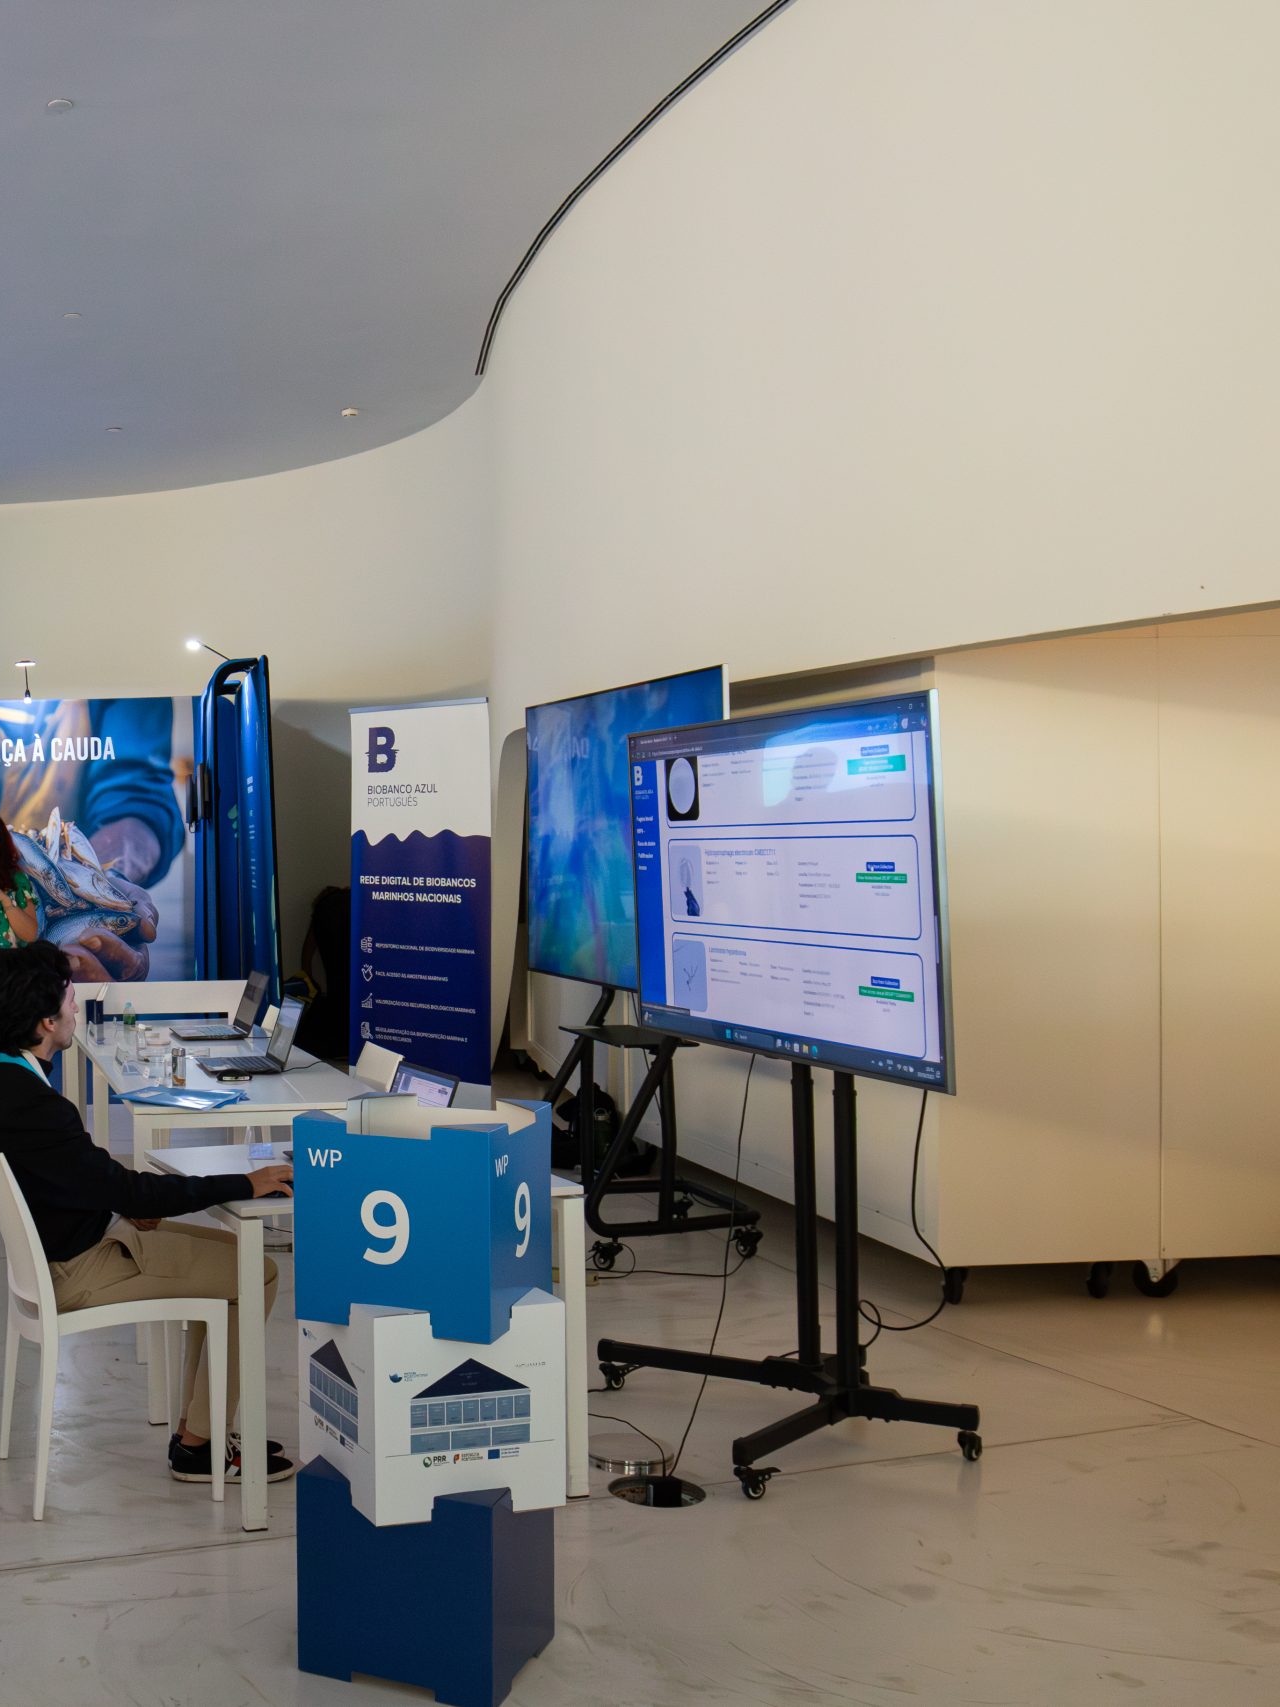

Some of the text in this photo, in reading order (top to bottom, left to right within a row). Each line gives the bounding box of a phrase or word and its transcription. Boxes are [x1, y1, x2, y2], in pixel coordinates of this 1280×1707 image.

[32, 733, 45, 762] À
[51, 736, 116, 762] CAUDA
[366, 726, 399, 774] B
[367, 783, 438, 795] BIOBANCO AZUL
[367, 796, 418, 808] PORTUGUÊS
[359, 875, 477, 888] REDE DIGITAL DE BIOBANCOS
[371, 891, 462, 904] MARINHOS NACIONAIS
[307, 1147, 343, 1169] WP
[494, 1154, 509, 1178] WP
[360, 1189, 410, 1266] 9
[514, 1181, 531, 1258] 9
[433, 1455, 447, 1463] PRR
